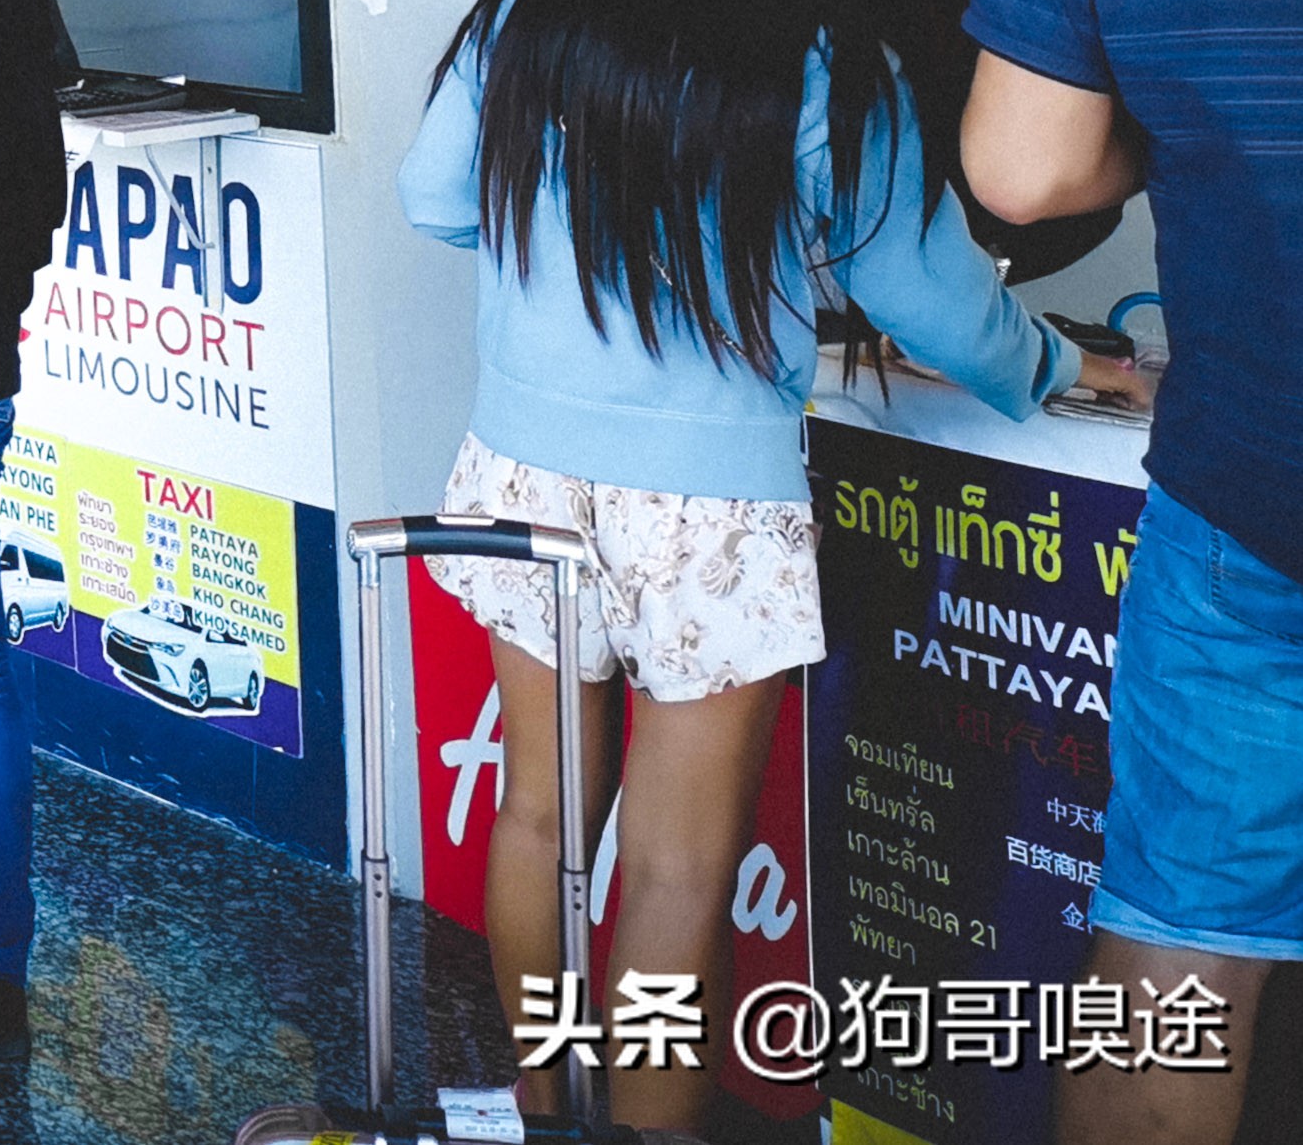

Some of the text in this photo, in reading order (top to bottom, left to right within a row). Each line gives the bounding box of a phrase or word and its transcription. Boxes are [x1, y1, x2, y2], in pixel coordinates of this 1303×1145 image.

[45, 282, 265, 371] AIRPORT
[45, 339, 270, 429] LIMOUSINE
[0, 498, 55, 532] AN PHE
[137, 469, 214, 521] TAXI
[189, 523, 258, 558] PATTAYA
[835, 475, 919, 568] รถตู้
[936, 483, 1062, 583] แท็กซี่
[190, 543, 255, 576] RAYONG
[192, 563, 266, 600] BANGKOK
[193, 586, 285, 629] KHO CHANG
[194, 611, 286, 652] KHO SAMED
[894, 629, 1112, 722] PATTAYA
[844, 734, 954, 789] จอมเทียน
[847, 829, 950, 886] เกาะล้าน
[849, 875, 997, 951] เทอมินอล 21
[849, 913, 916, 966] พัทยา
